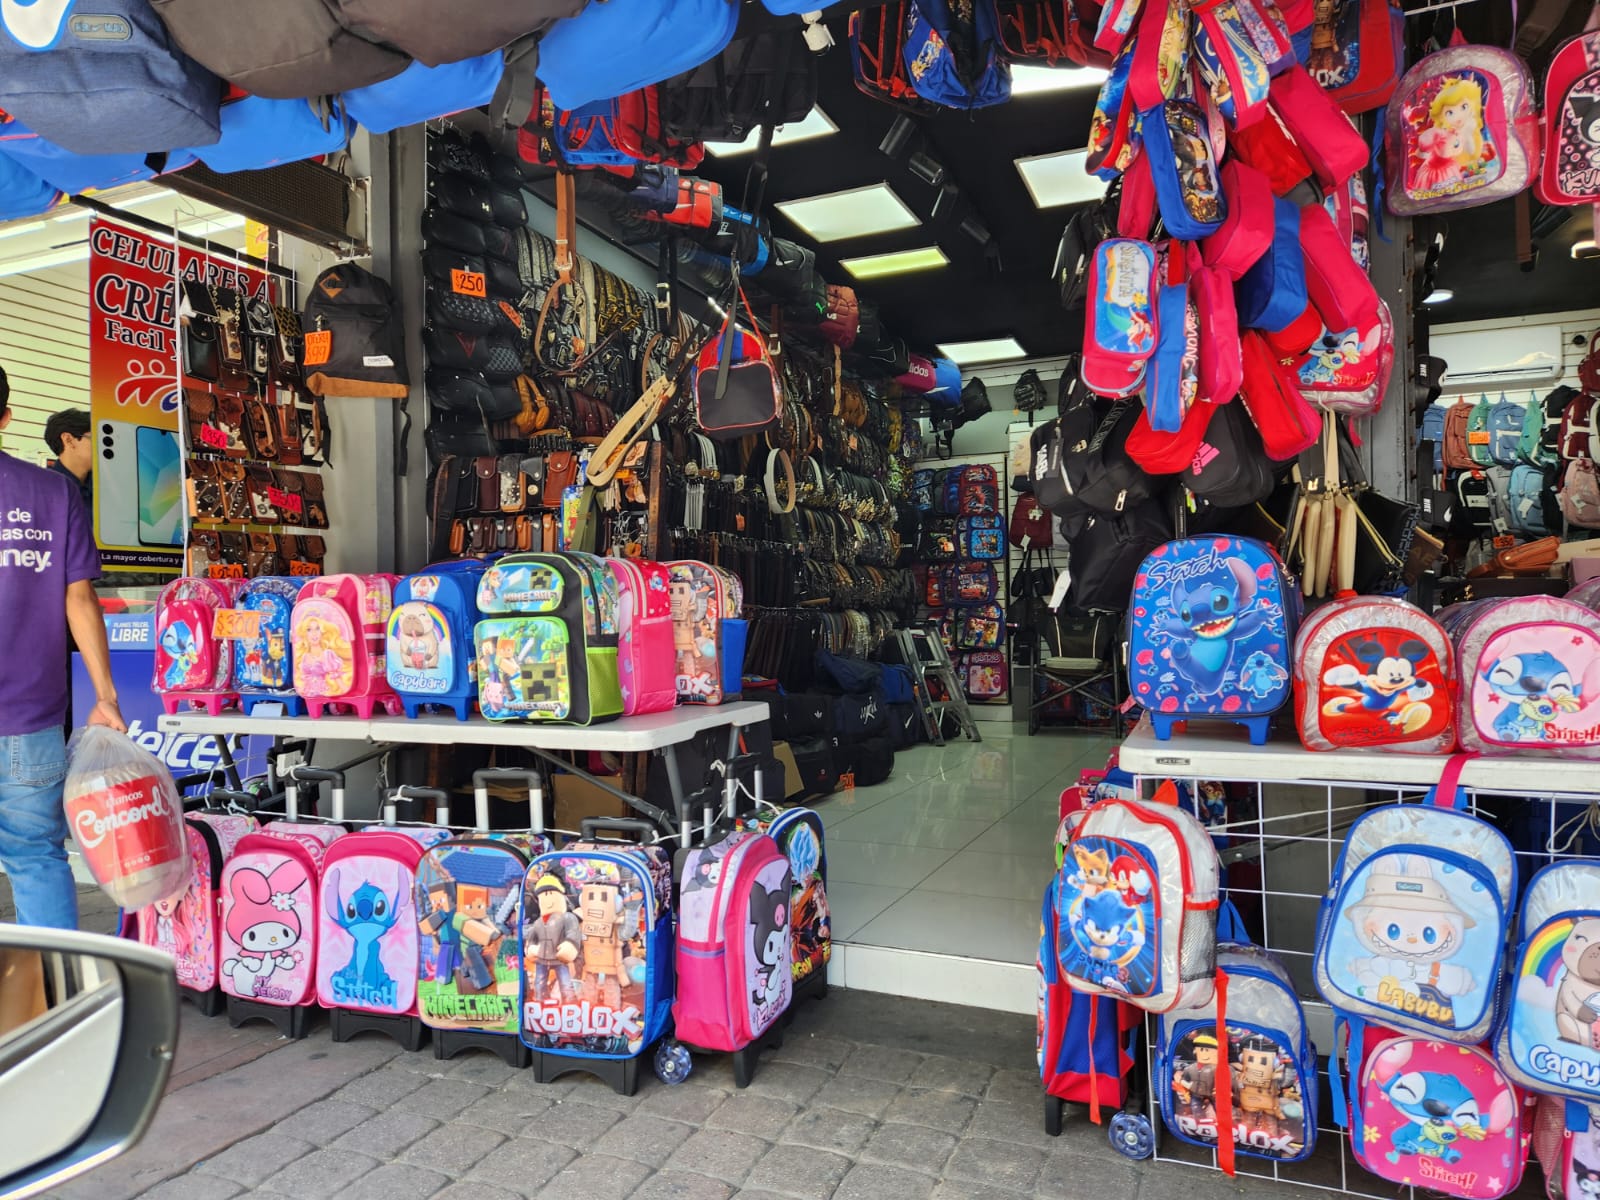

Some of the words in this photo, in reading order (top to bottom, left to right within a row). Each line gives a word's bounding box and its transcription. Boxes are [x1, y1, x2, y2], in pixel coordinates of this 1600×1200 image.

[1563, 168, 1600, 193] KU
[105, 319, 165, 352] Facil
[909, 362, 929, 377] idas
[7, 508, 32, 523] de
[25, 528, 52, 541] con
[101, 553, 111, 561] La
[113, 554, 136, 563] mayor
[139, 555, 173, 564] cobertura
[111, 628, 149, 642] LIBRE
[391, 671, 448, 690] Capybara
[1376, 981, 1453, 1022] LABUBU
[1529, 1045, 1600, 1087] Capy
